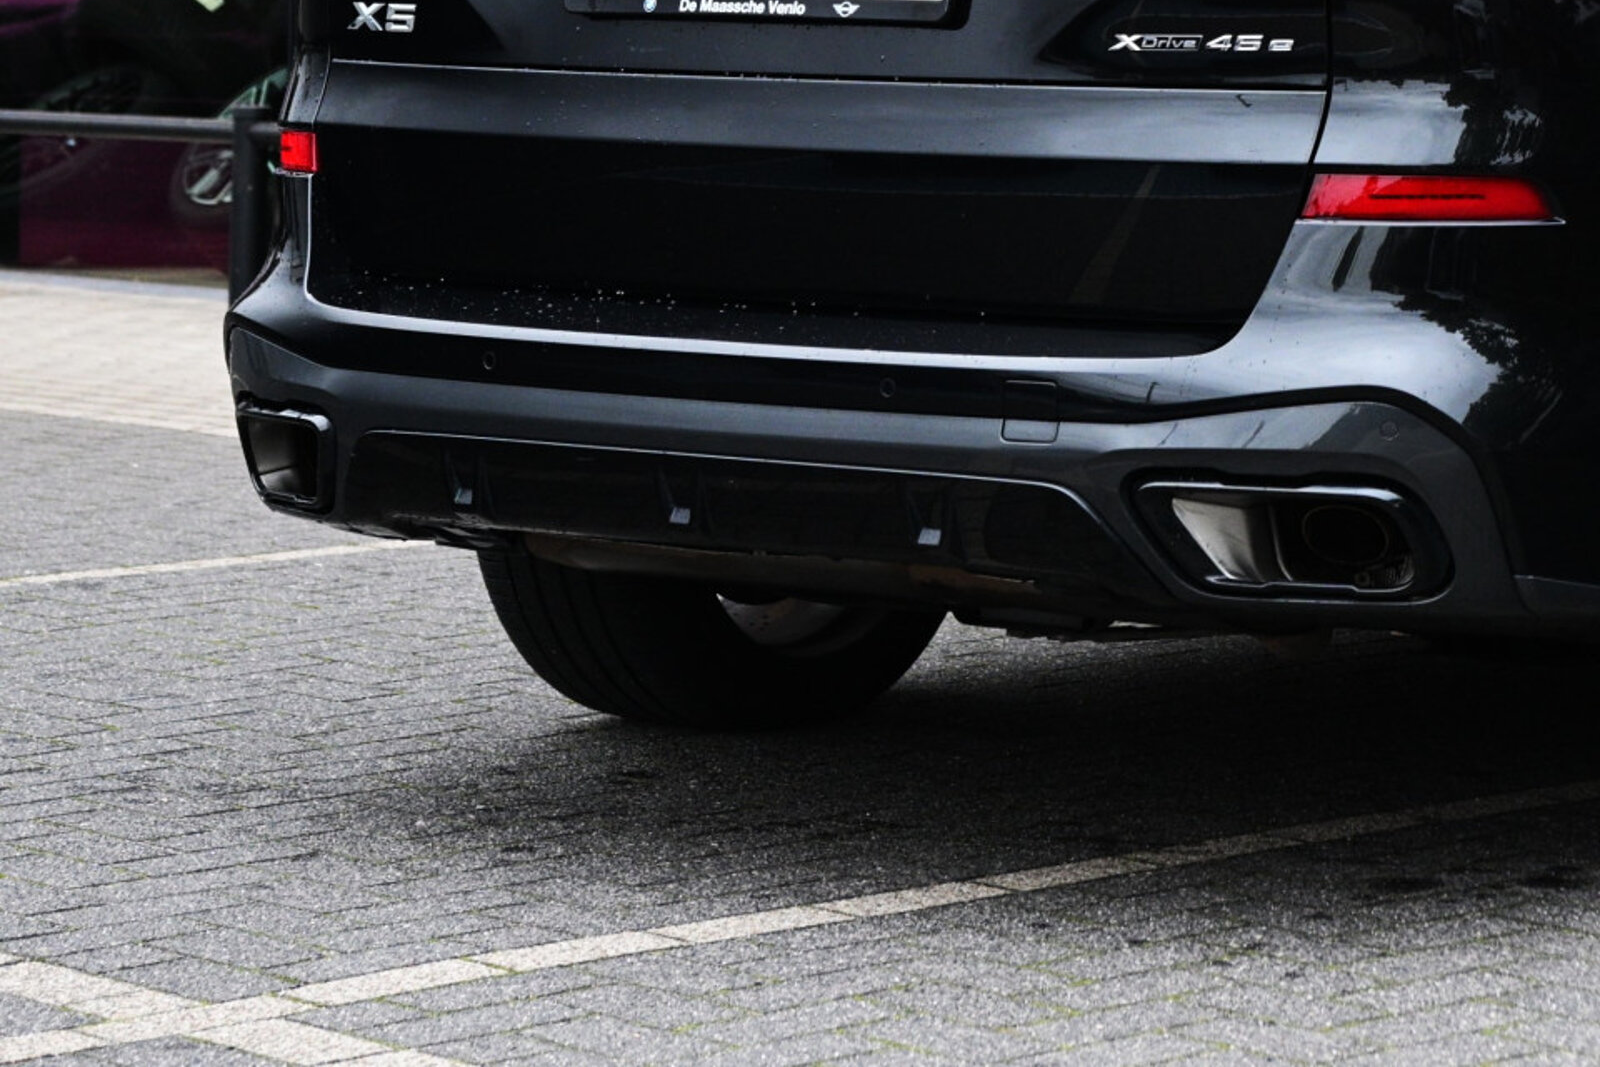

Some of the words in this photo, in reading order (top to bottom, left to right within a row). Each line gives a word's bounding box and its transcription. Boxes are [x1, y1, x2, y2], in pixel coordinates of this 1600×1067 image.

[347, 1, 417, 32] X5
[768, 0, 807, 15] Venlo
[1205, 34, 1264, 52] 45
